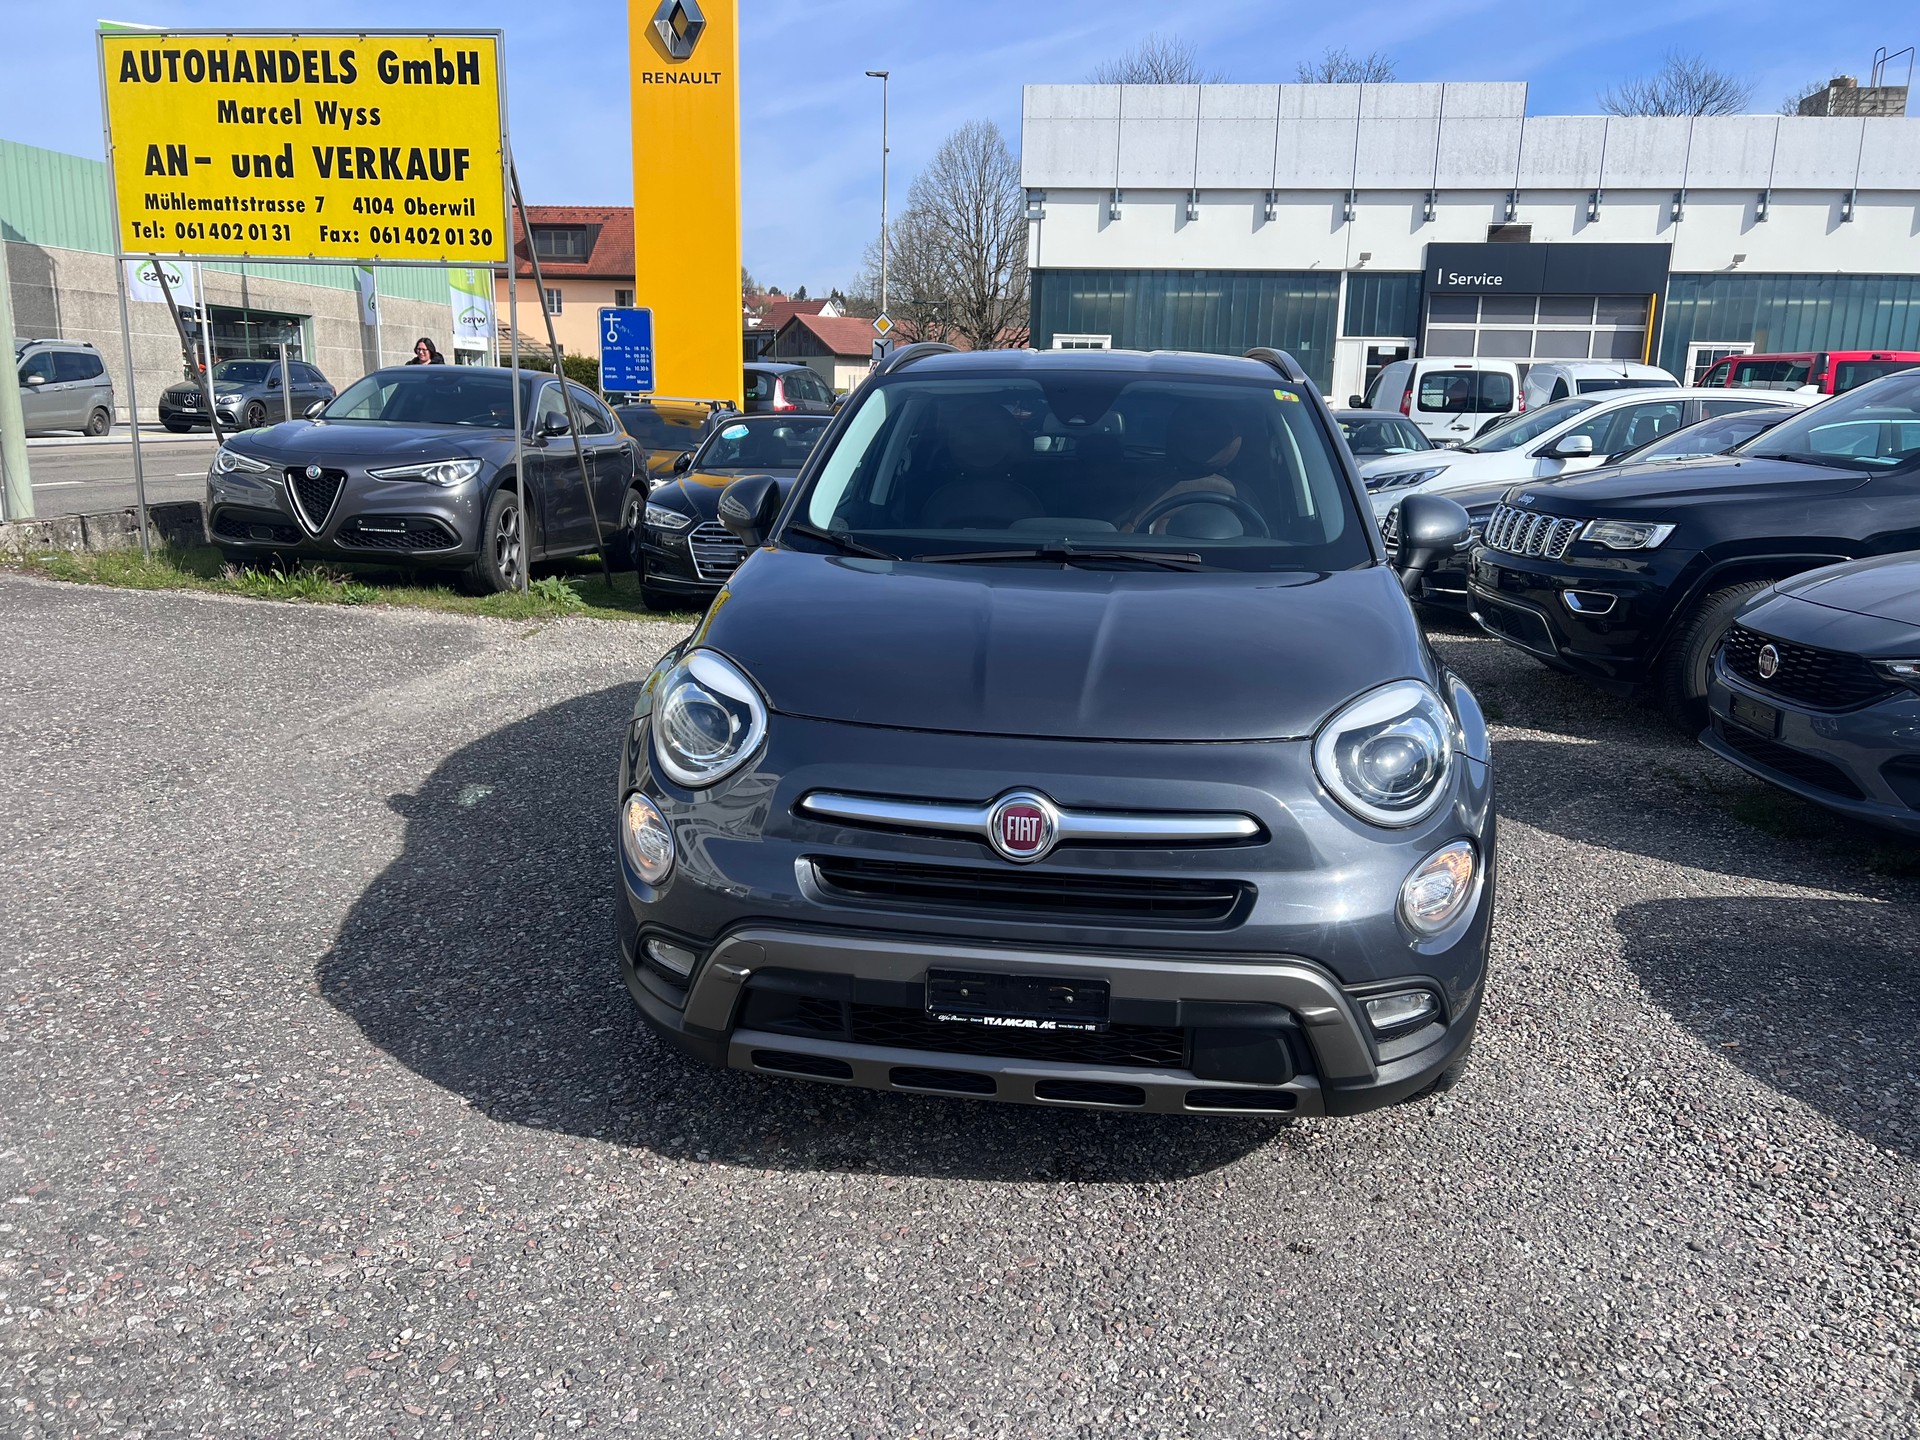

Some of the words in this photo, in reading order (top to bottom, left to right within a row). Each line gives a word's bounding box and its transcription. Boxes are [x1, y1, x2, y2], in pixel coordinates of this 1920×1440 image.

[119, 48, 358, 85] AUTOHANDELS
[377, 47, 480, 86] GmbH
[642, 72, 722, 84] RENAULT
[217, 98, 302, 125] Marcel
[314, 100, 381, 131] Wyss
[231, 142, 295, 179] und
[311, 145, 470, 182] VERKAUF
[144, 191, 306, 213] Mühlemattstrasse
[314, 196, 325, 213] 7
[352, 196, 395, 215] 4104
[403, 196, 476, 217] Oberwil
[131, 220, 165, 239] Tel:
[319, 225, 360, 244] Fax:
[1448, 272, 1503, 286] Service
[1007, 815, 1040, 842] FIAT
[983, 1016, 1038, 1029] ITAMCAR
[1038, 1020, 1057, 1030] AG
